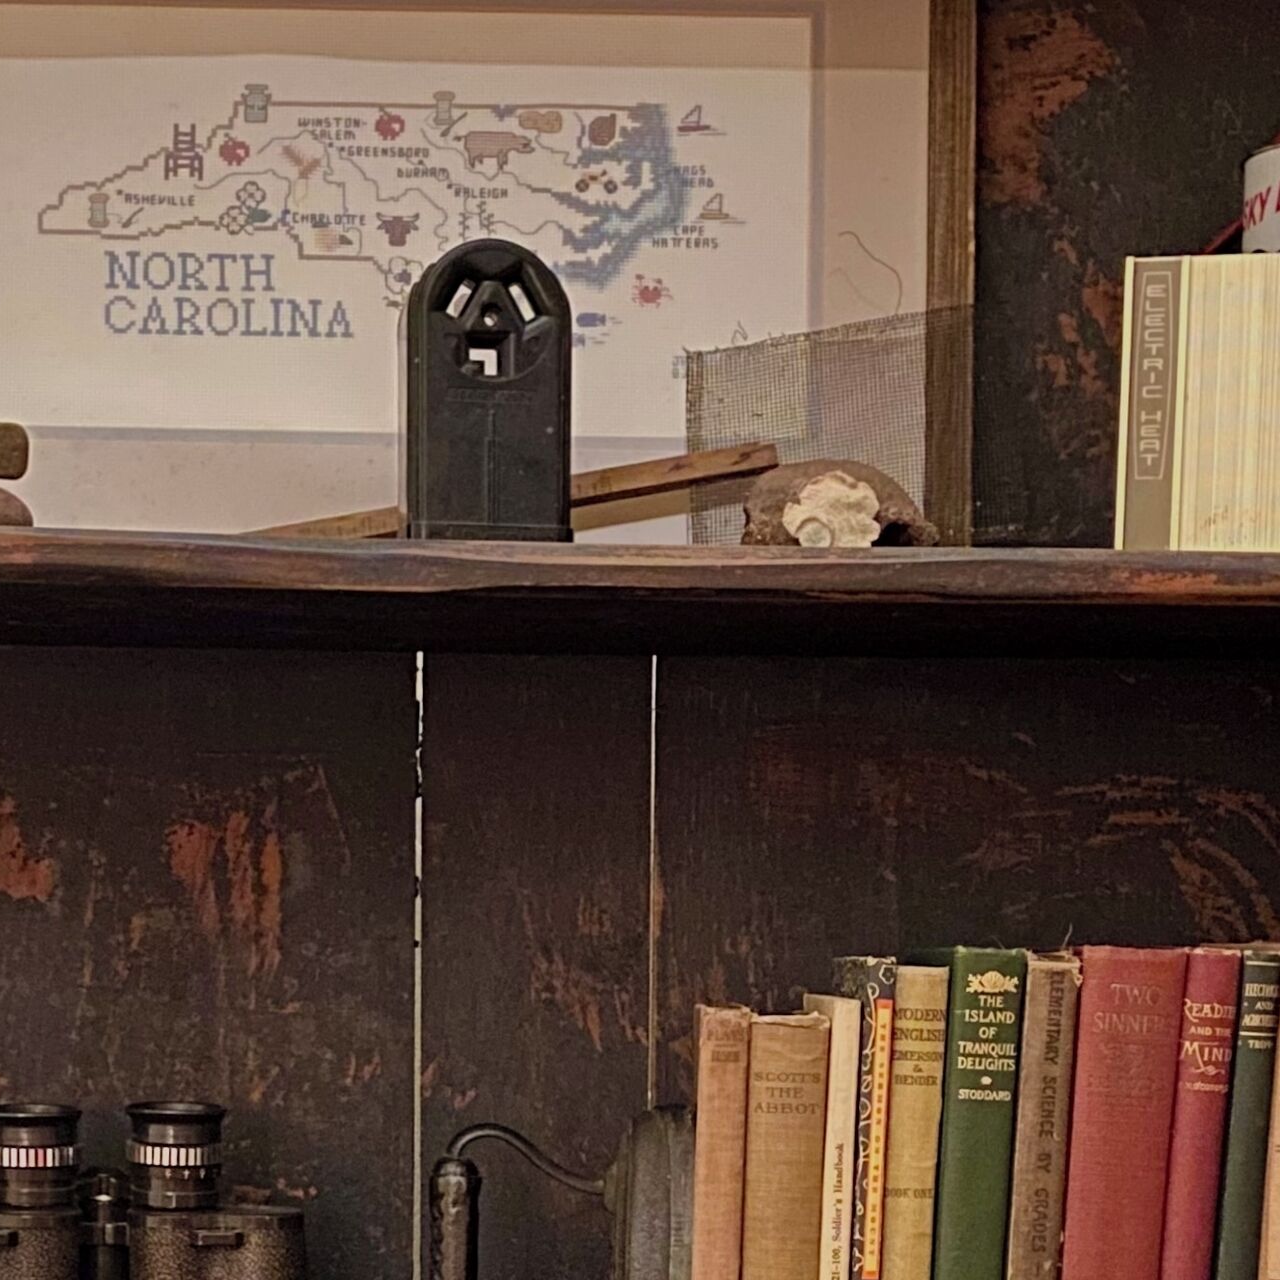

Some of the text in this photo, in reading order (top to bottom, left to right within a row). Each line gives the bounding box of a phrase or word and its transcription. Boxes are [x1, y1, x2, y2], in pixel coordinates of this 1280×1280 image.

[311, 129, 356, 141] SALEM
[347, 147, 430, 159] GREENSBORO
[124, 192, 196, 207] ASHEVILLE
[454, 187, 509, 199] RALEIGH
[291, 214, 367, 226] CHARLOTTE
[673, 225, 705, 237] CAPE
[652, 237, 719, 249] HATTERAS
[104, 250, 275, 291] NORTH
[104, 295, 354, 338] CAROLINA
[1141, 282, 1167, 400] ELECTRIC
[1139, 410, 1163, 467] HEAT
[979, 995, 1004, 1008] THE
[964, 1009, 1015, 1025] ISLAND
[1044, 970, 1066, 1066] ELEMENTARY
[893, 1029, 945, 1042] ENGLISH
[978, 1027, 998, 1039] OF
[1189, 1026, 1212, 1036] AND
[957, 1041, 1018, 1058] TRANQUIL
[957, 1057, 1016, 1071] DELIGHTS
[753, 1071, 821, 1083] SCOTT'S
[766, 1087, 805, 1099] THE
[958, 1089, 1012, 1102] STODDARD
[753, 1102, 821, 1115] ABBOT
[1038, 1075, 1057, 1139] SCIENCE
[833, 1143, 845, 1194] Handbook
[1033, 1151, 1053, 1174] BY
[832, 1199, 843, 1242] Soldier's
[1030, 1187, 1050, 1253] GRADES
